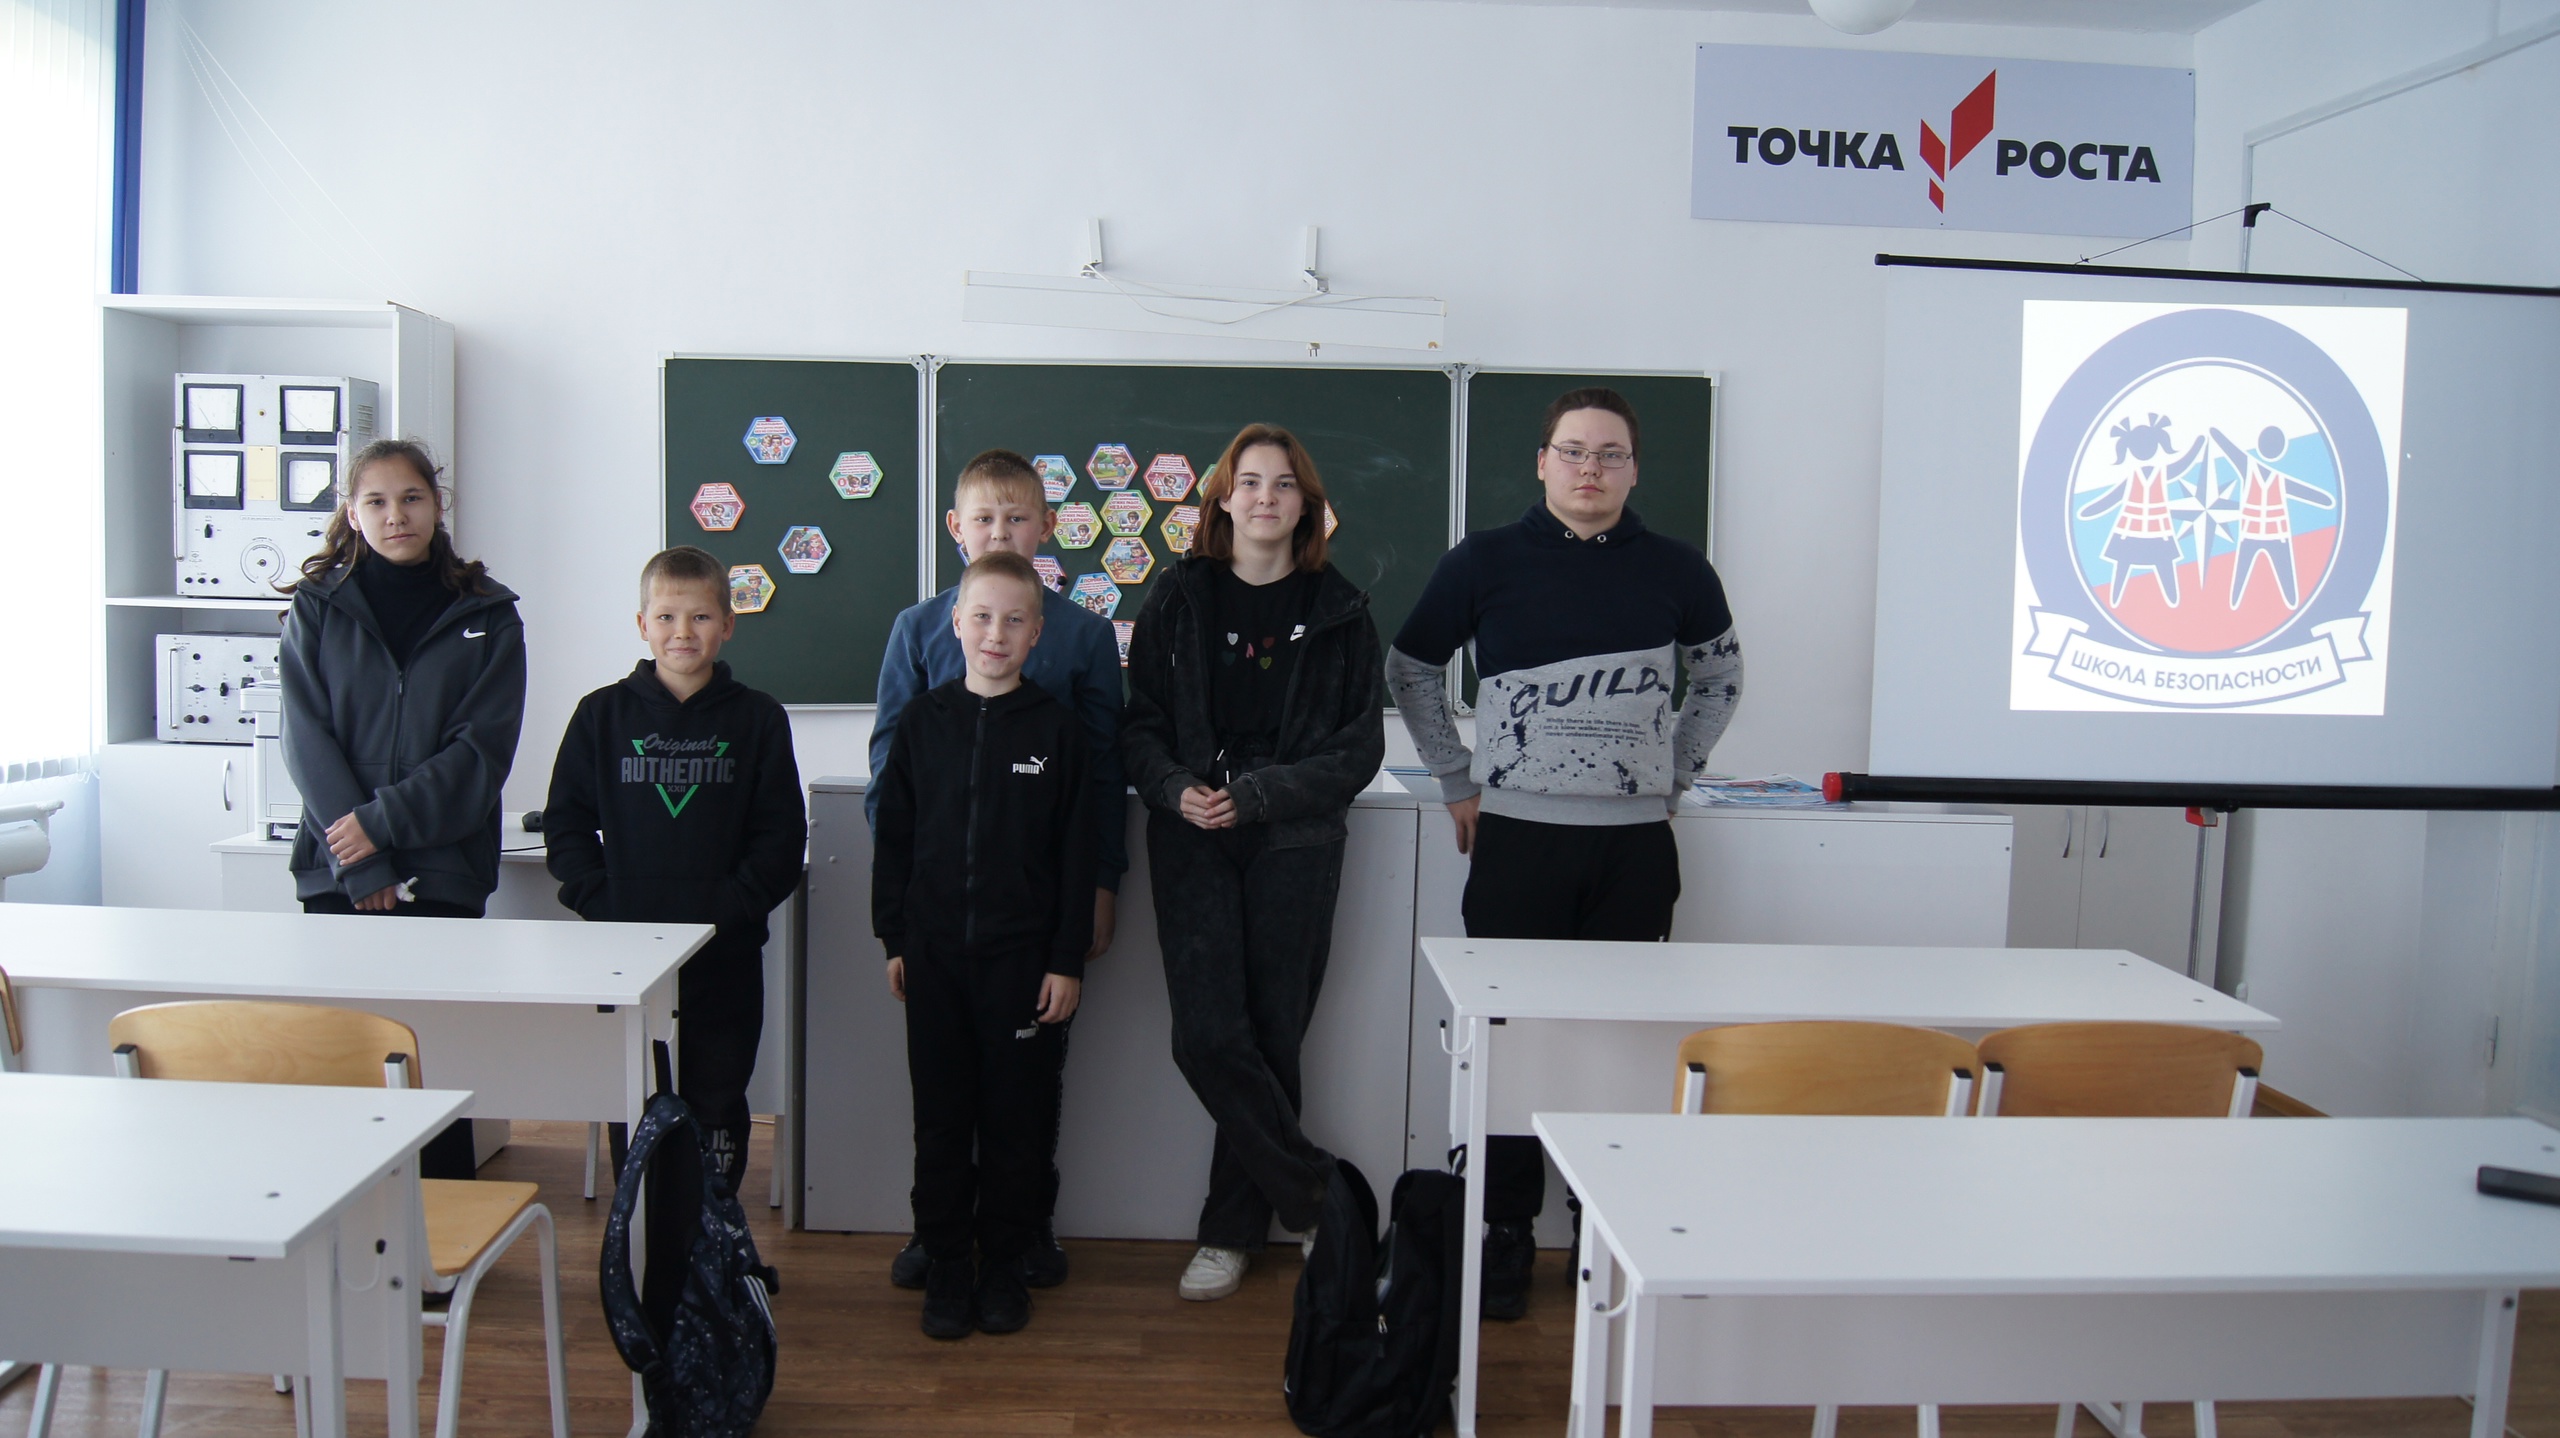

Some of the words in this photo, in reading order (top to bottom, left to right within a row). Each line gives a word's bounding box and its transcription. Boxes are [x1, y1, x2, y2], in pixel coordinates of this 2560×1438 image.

[1727, 125, 1905, 171] ТОЧКА
[1996, 139, 2162, 183] РОСТА
[2070, 649, 2147, 687] ШКОЛА
[2154, 655, 2323, 691] БЕЗОПАСНОСТИ
[1510, 666, 1661, 718] GUILD
[643, 733, 718, 757] Original
[621, 757, 736, 784] AUTHENTIC
[1012, 763, 1040, 774] PUMA
[1015, 1027, 1037, 1039] PUMA
